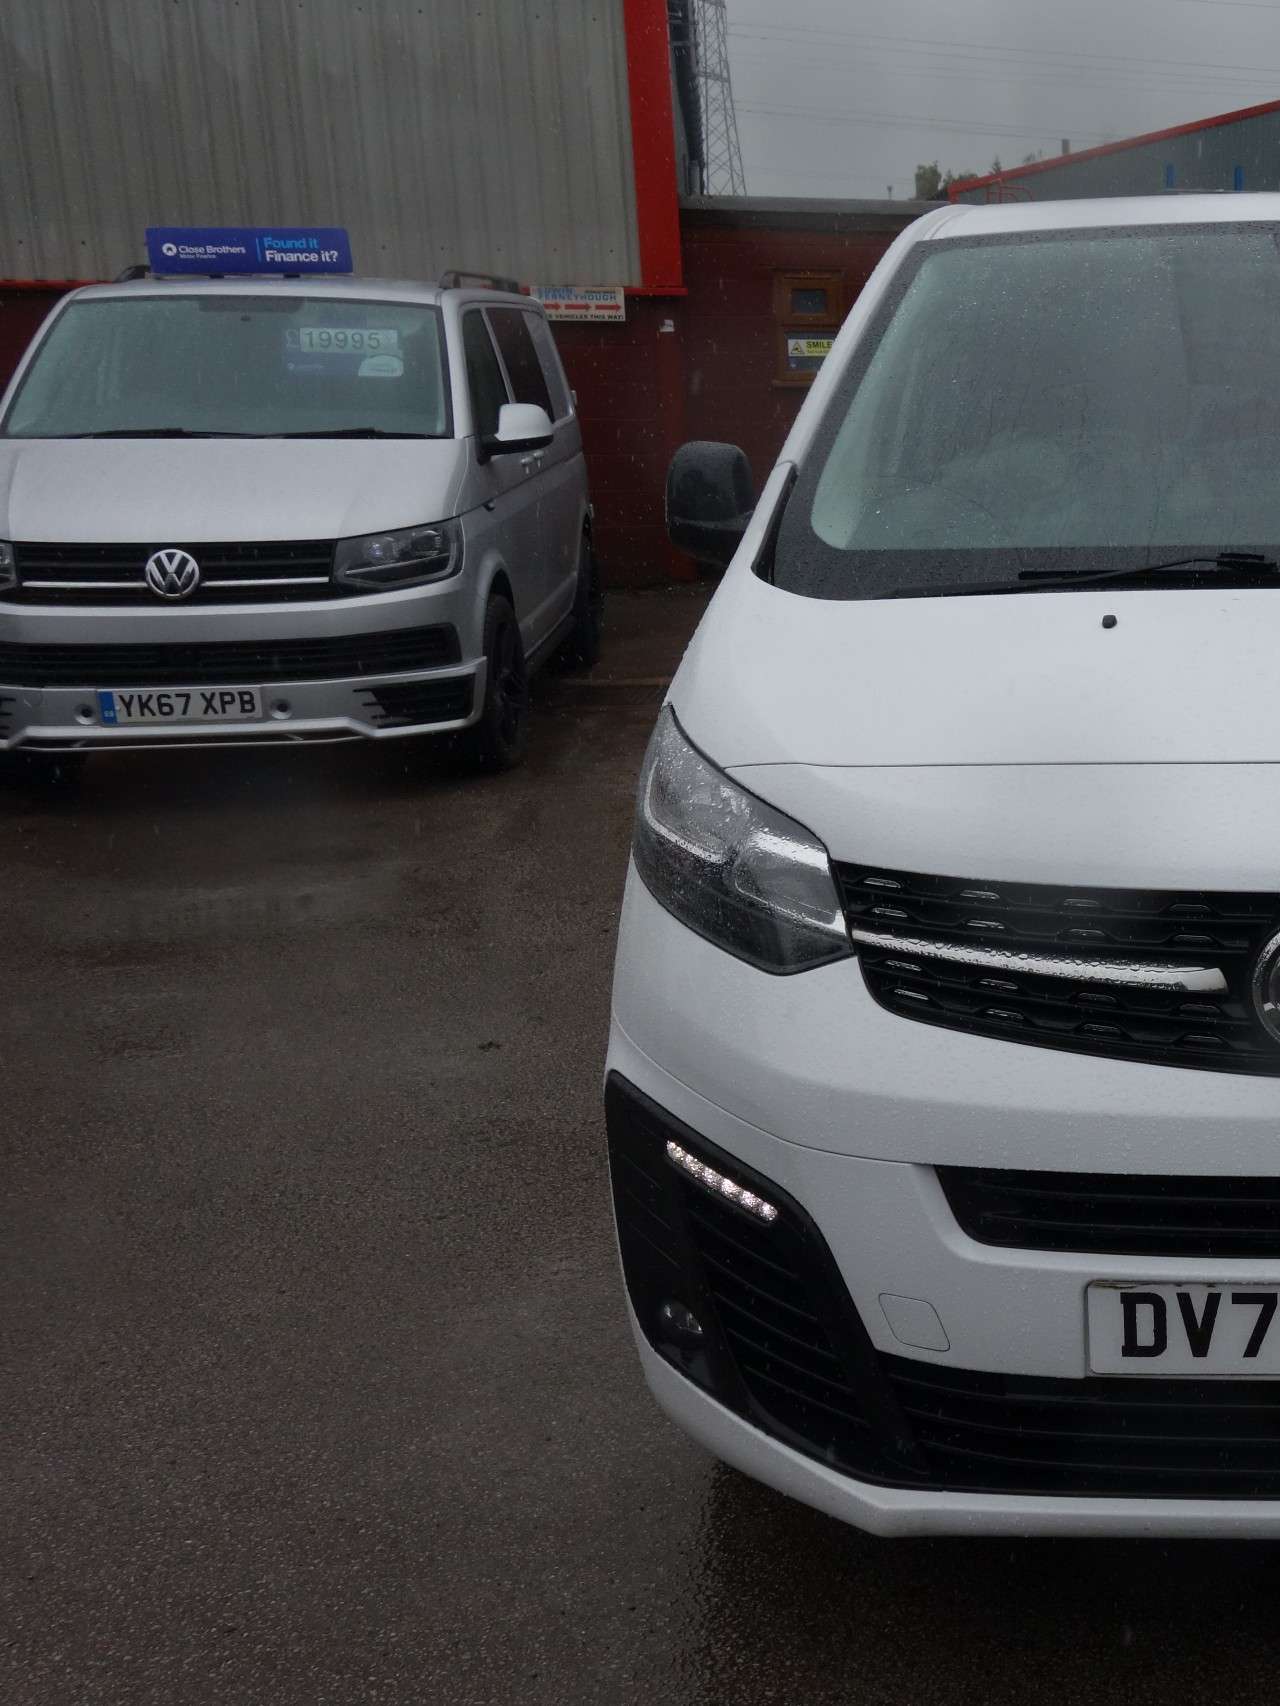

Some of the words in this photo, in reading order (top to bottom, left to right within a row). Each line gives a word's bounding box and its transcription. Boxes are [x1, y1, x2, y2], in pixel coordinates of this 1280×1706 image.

[263, 237, 306, 249] Found
[309, 237, 319, 248] it
[179, 245, 205, 254] Close
[207, 245, 246, 254] Brothers
[266, 250, 319, 263] Finance
[320, 250, 339, 263] it?
[305, 330, 381, 349] 19995
[806, 341, 833, 349] SMILE
[118, 693, 192, 717] YK67
[200, 691, 256, 715] XPB
